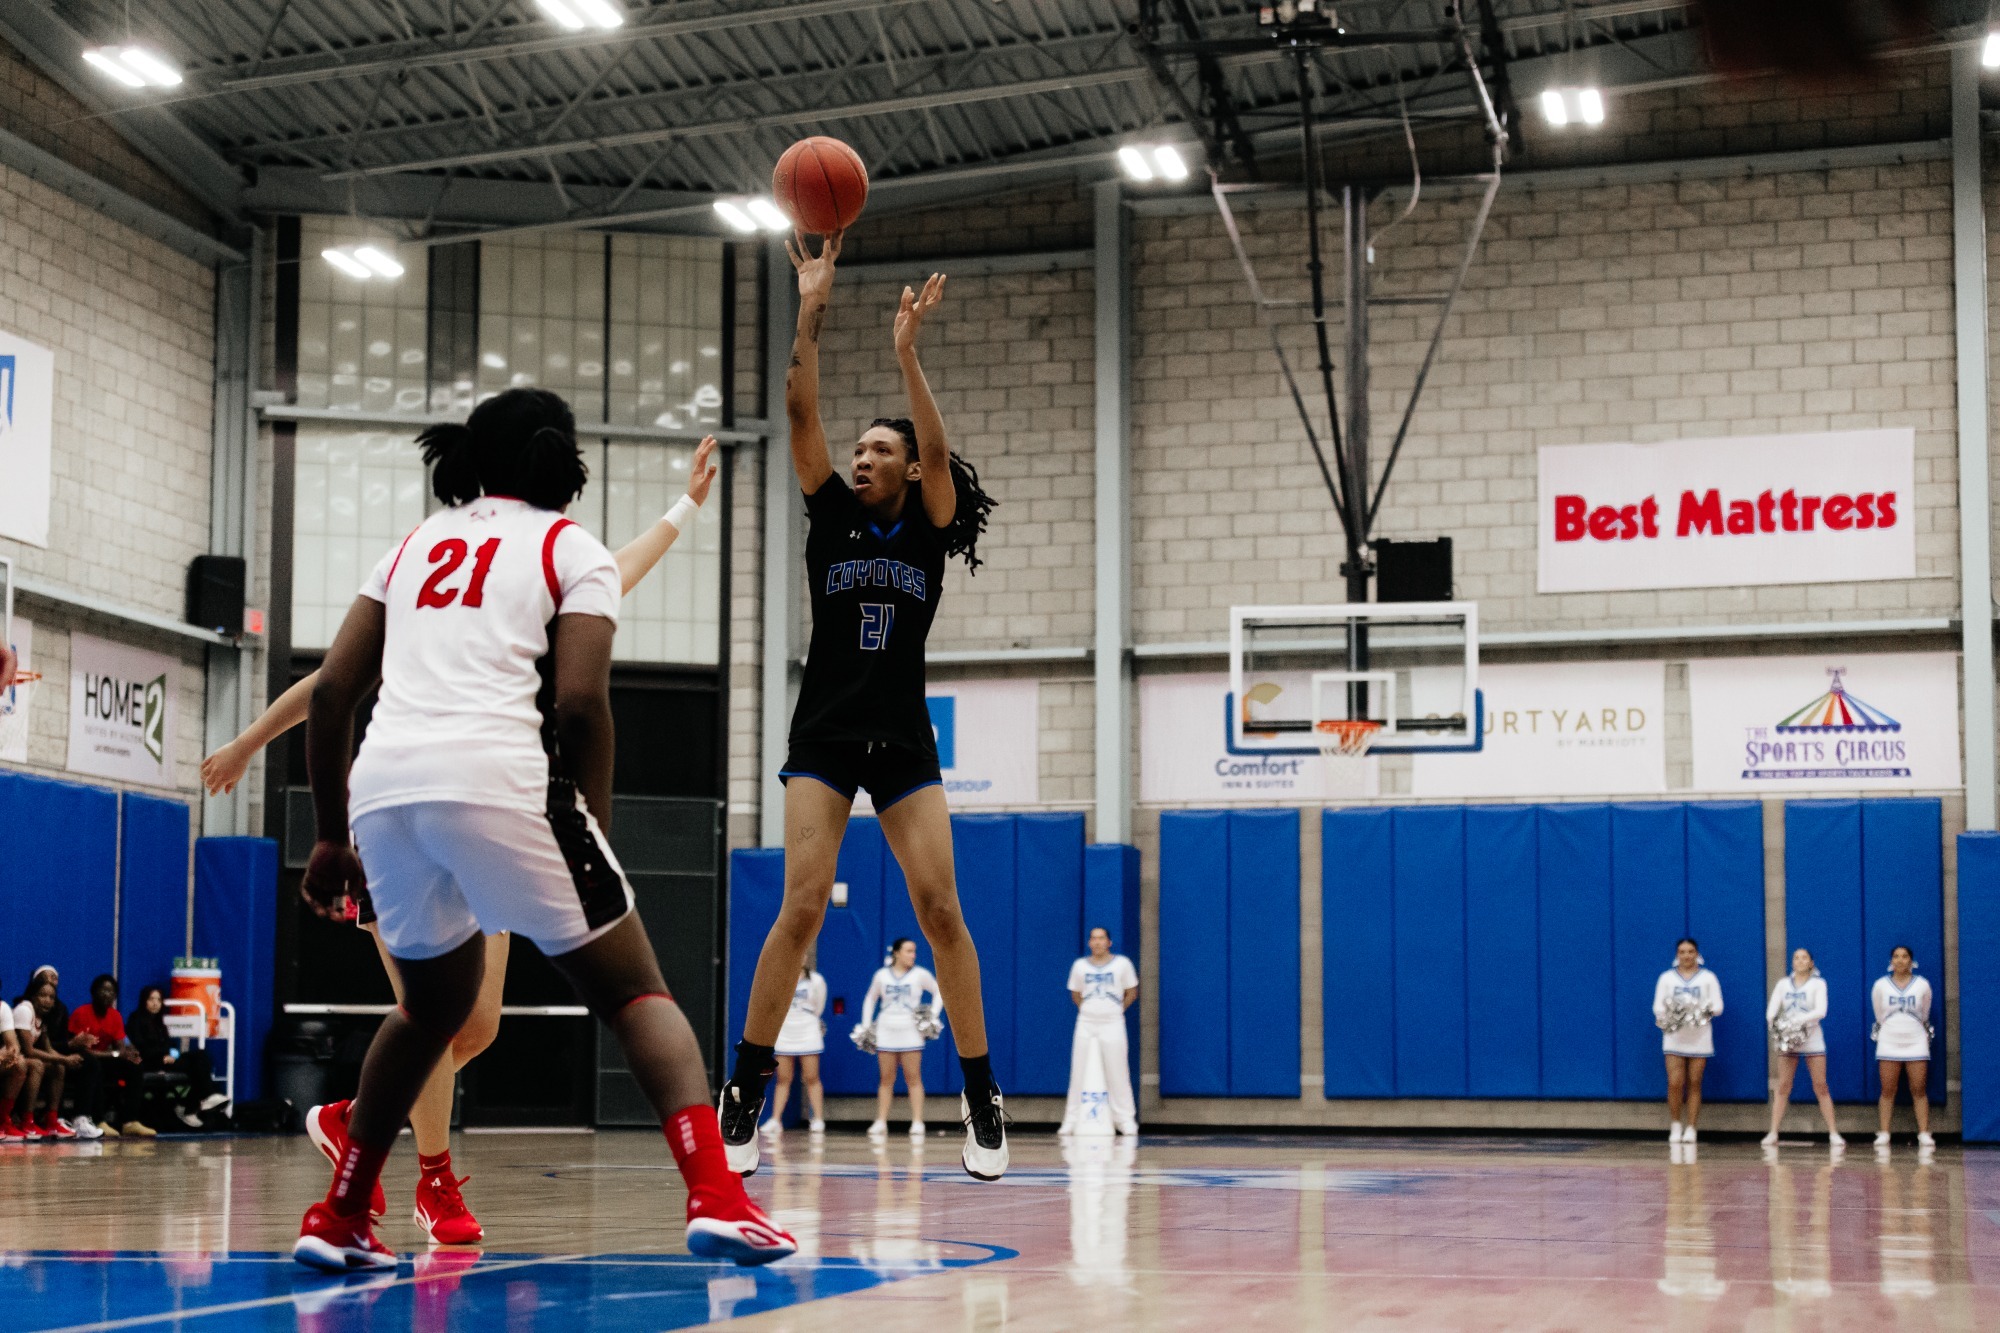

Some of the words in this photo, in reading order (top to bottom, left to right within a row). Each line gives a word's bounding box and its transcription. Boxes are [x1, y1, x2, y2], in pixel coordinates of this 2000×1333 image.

[1554, 493, 1659, 542] Best
[1676, 487, 1897, 538] Mattress
[416, 537, 502, 610] 21
[826, 558, 926, 602] COYOTES
[859, 602, 895, 650] 21
[1214, 755, 1299, 777] Comfort
[1745, 741, 1825, 767] SPORTS
[1836, 739, 1906, 766] CIRCUS
